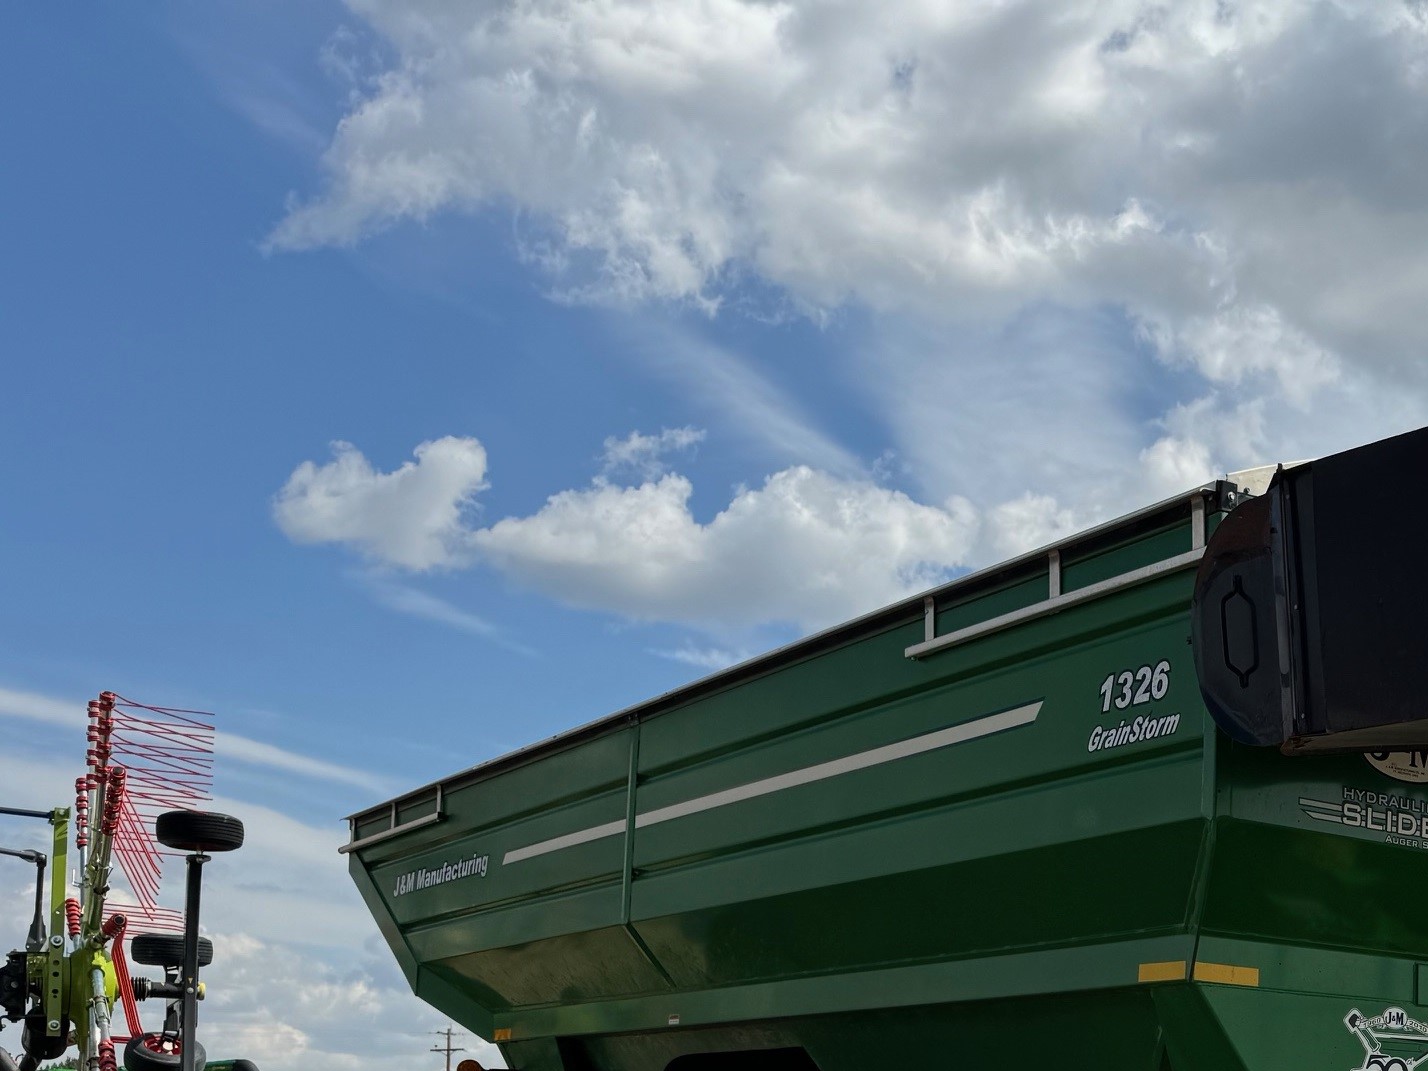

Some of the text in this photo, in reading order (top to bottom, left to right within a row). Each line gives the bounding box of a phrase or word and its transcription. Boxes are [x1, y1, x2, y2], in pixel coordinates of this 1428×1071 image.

[1100, 660, 1171, 713] 1326
[1087, 713, 1181, 753] GrainStorm
[1385, 834, 1419, 848] AUGER
[393, 853, 489, 897] J&M Manufacturing
[1385, 1011, 1405, 1026] J&M
